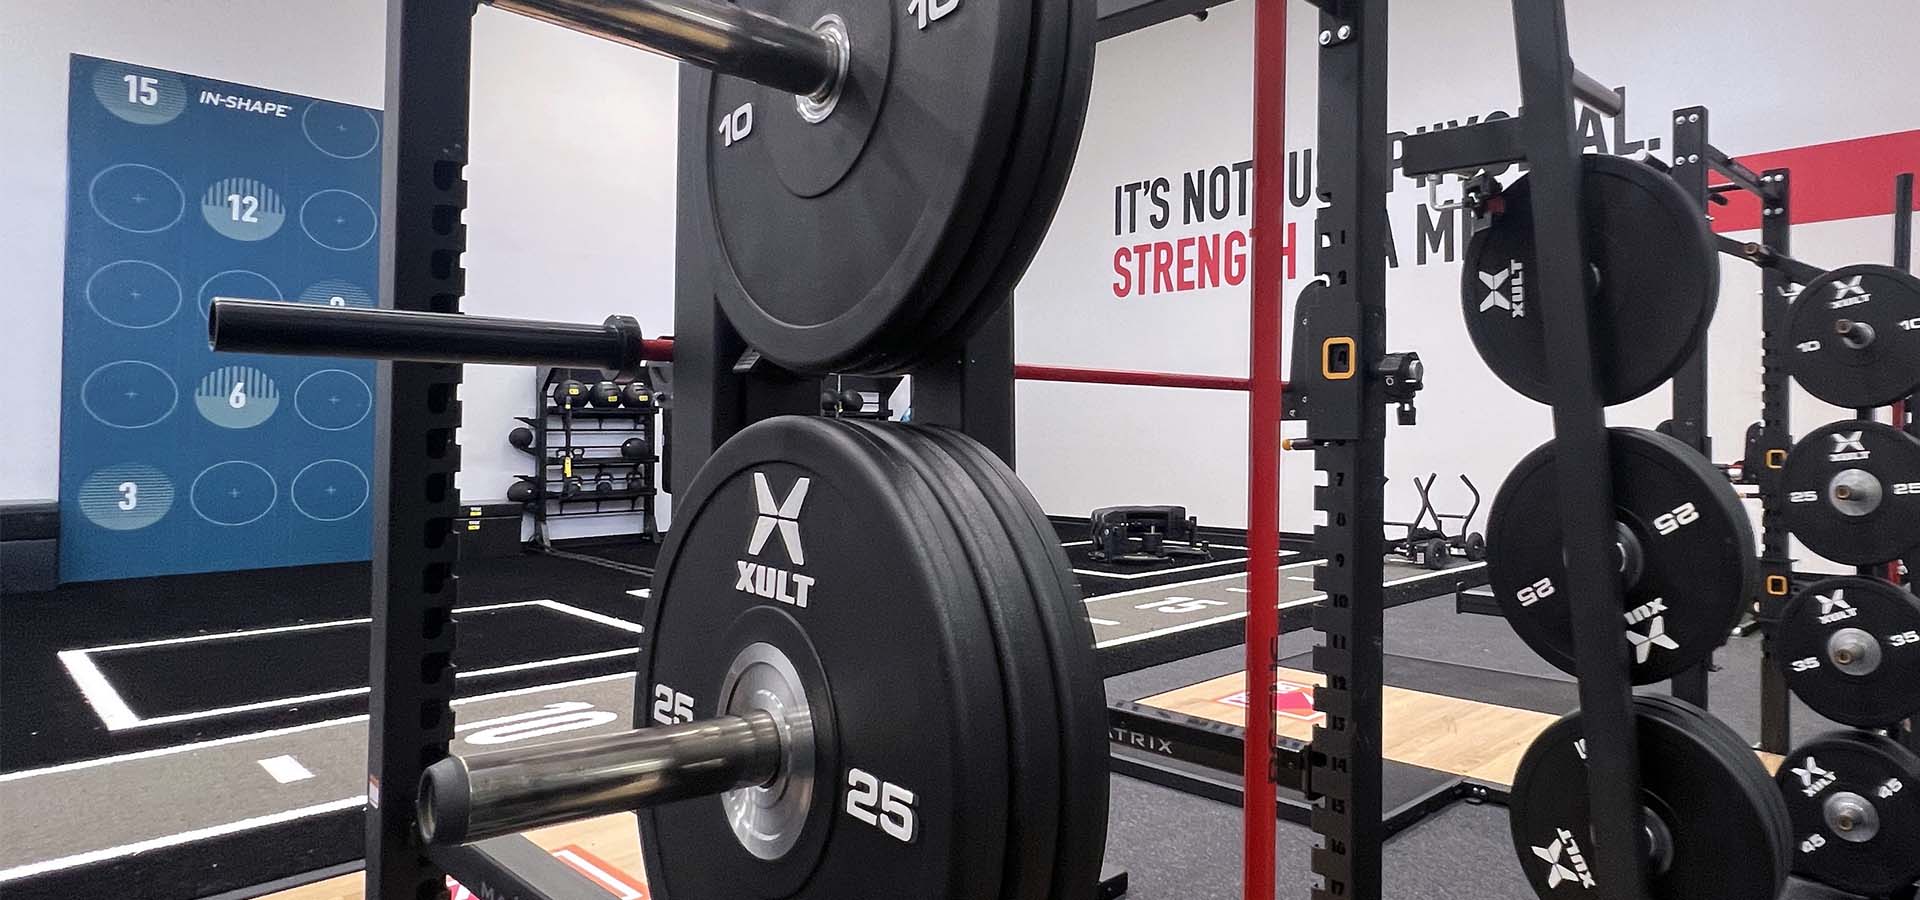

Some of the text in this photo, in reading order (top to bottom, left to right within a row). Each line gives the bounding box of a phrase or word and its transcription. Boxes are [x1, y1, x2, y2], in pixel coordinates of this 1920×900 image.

[123, 74, 158, 106] 15
[718, 102, 753, 147] 10
[228, 193, 259, 223] 12
[1115, 177, 1170, 236] IT'S
[1183, 160, 1253, 225] NOT
[1112, 222, 1296, 298] STRENGH
[1510, 259, 1524, 318] XULT
[1796, 340, 1821, 353] 10
[229, 382, 247, 409] 6
[118, 481, 138, 511] 3
[1789, 490, 1818, 503] 25
[1893, 483, 1920, 495] 25
[1653, 502, 1700, 536] 25
[735, 560, 815, 609] XULT
[1516, 577, 1556, 607] 25
[1134, 596, 1229, 613] 15
[1889, 630, 1920, 647] 35
[1791, 656, 1820, 672] 35
[653, 683, 695, 726] 25
[454, 701, 618, 745] 10
[847, 767, 915, 843] 25
[1556, 827, 1597, 890] XULT
